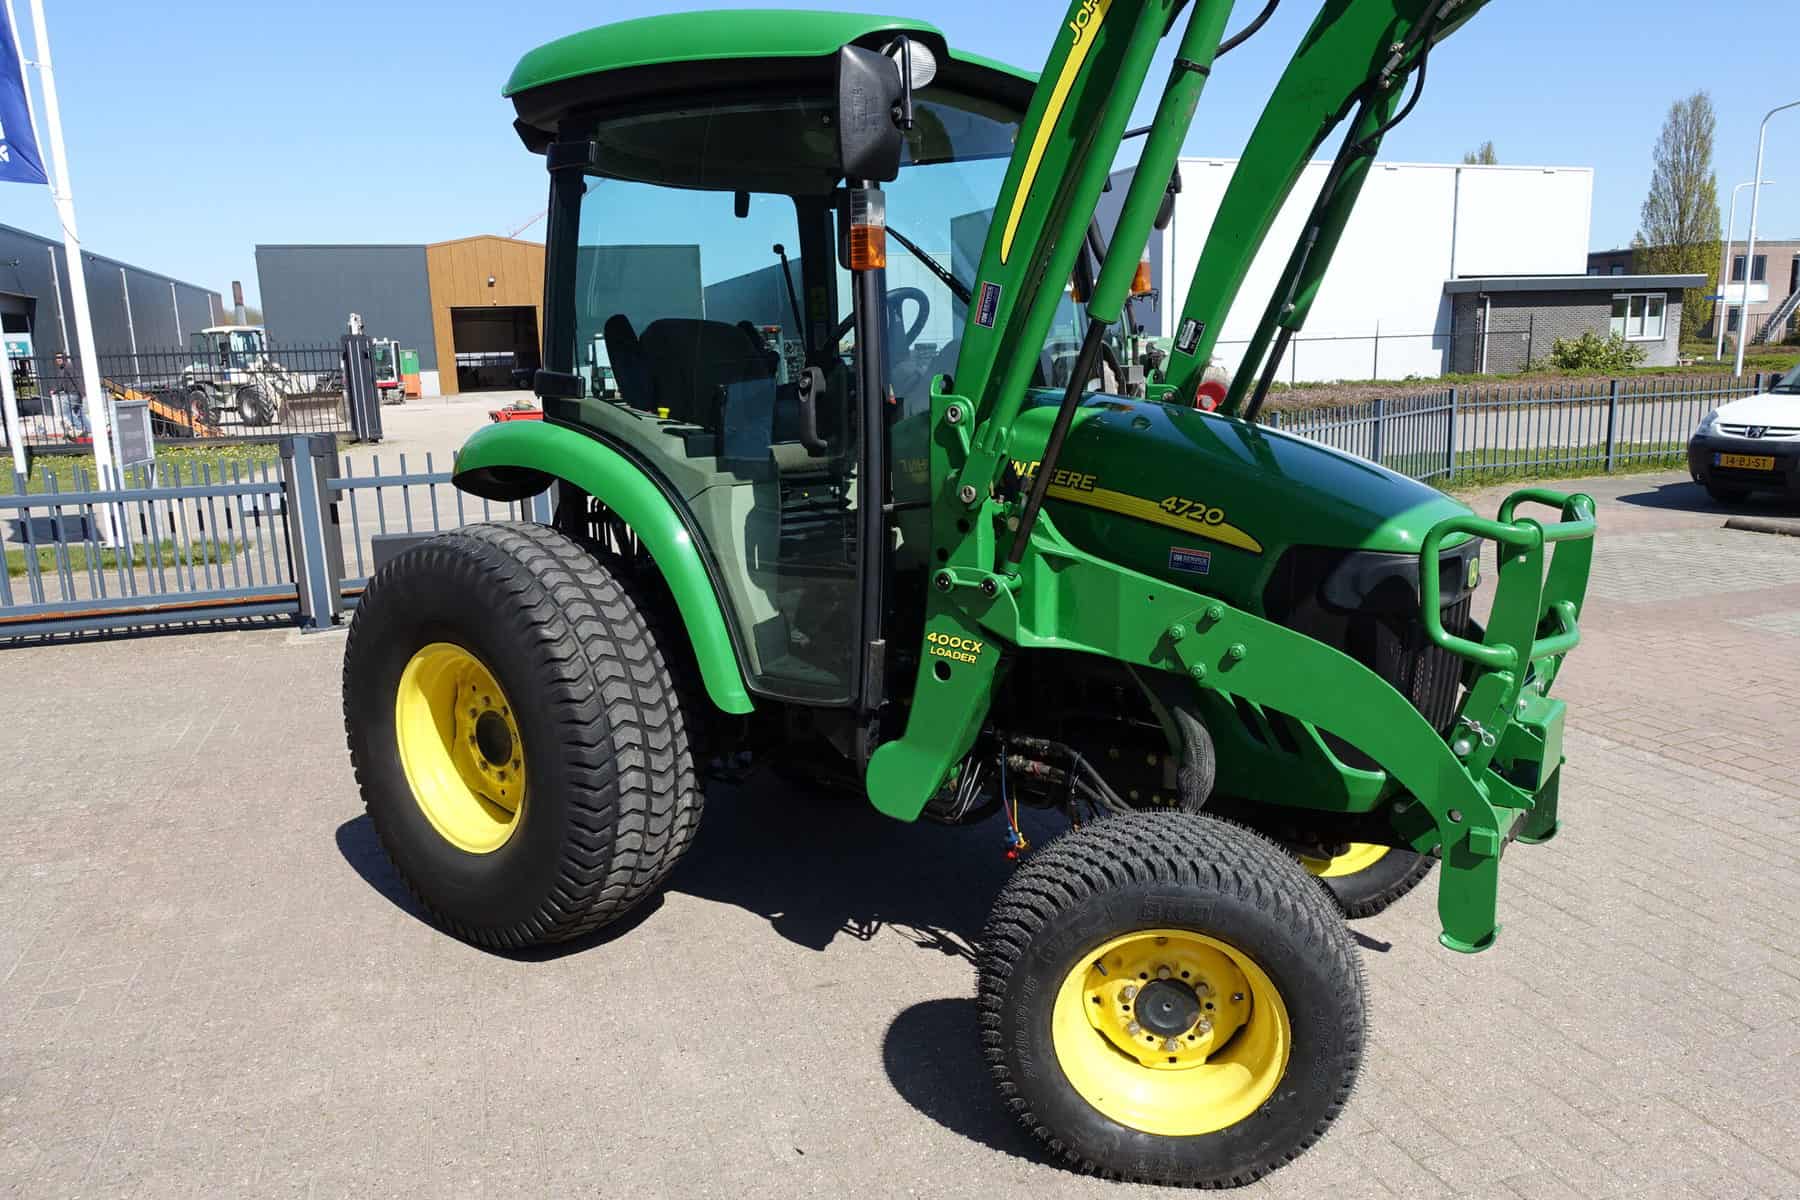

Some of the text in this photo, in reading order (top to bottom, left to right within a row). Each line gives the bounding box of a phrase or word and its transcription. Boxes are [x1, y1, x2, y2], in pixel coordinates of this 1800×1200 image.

[1160, 495, 1225, 524] 4720
[927, 632, 983, 654] 400CX
[930, 646, 977, 664] LOADER
